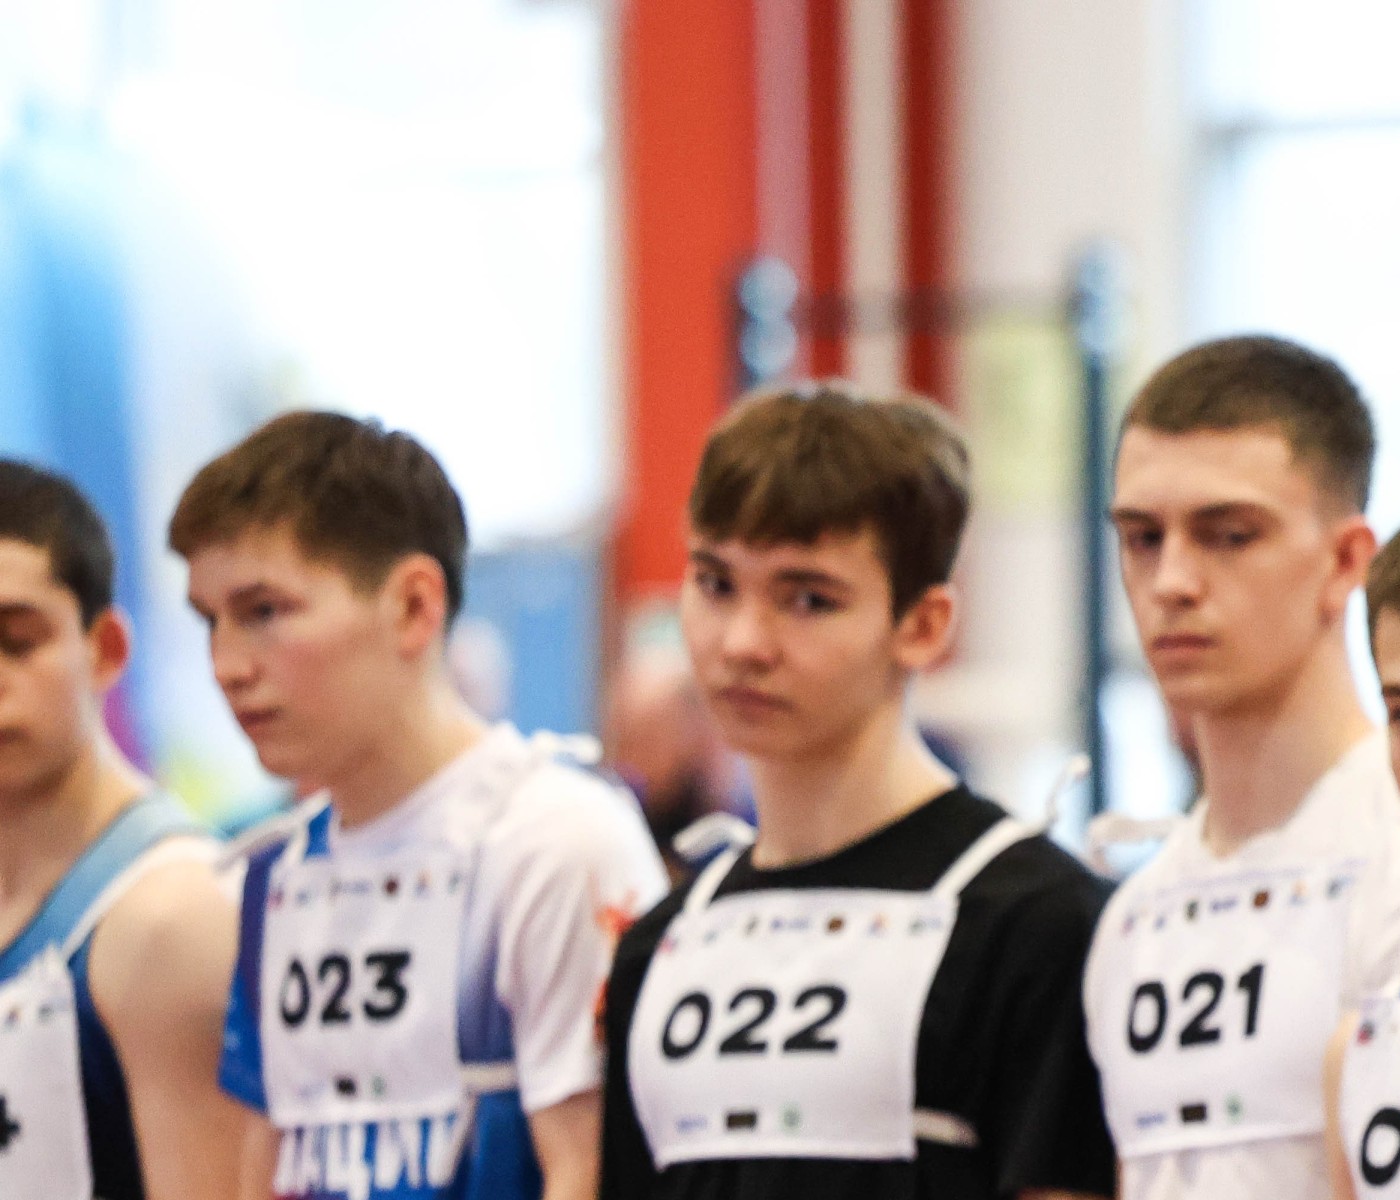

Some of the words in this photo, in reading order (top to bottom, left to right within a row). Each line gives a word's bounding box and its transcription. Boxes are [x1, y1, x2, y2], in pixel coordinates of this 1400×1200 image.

[280, 951, 411, 1028] 023
[661, 984, 847, 1059] 022
[1127, 962, 1265, 1053] 021
